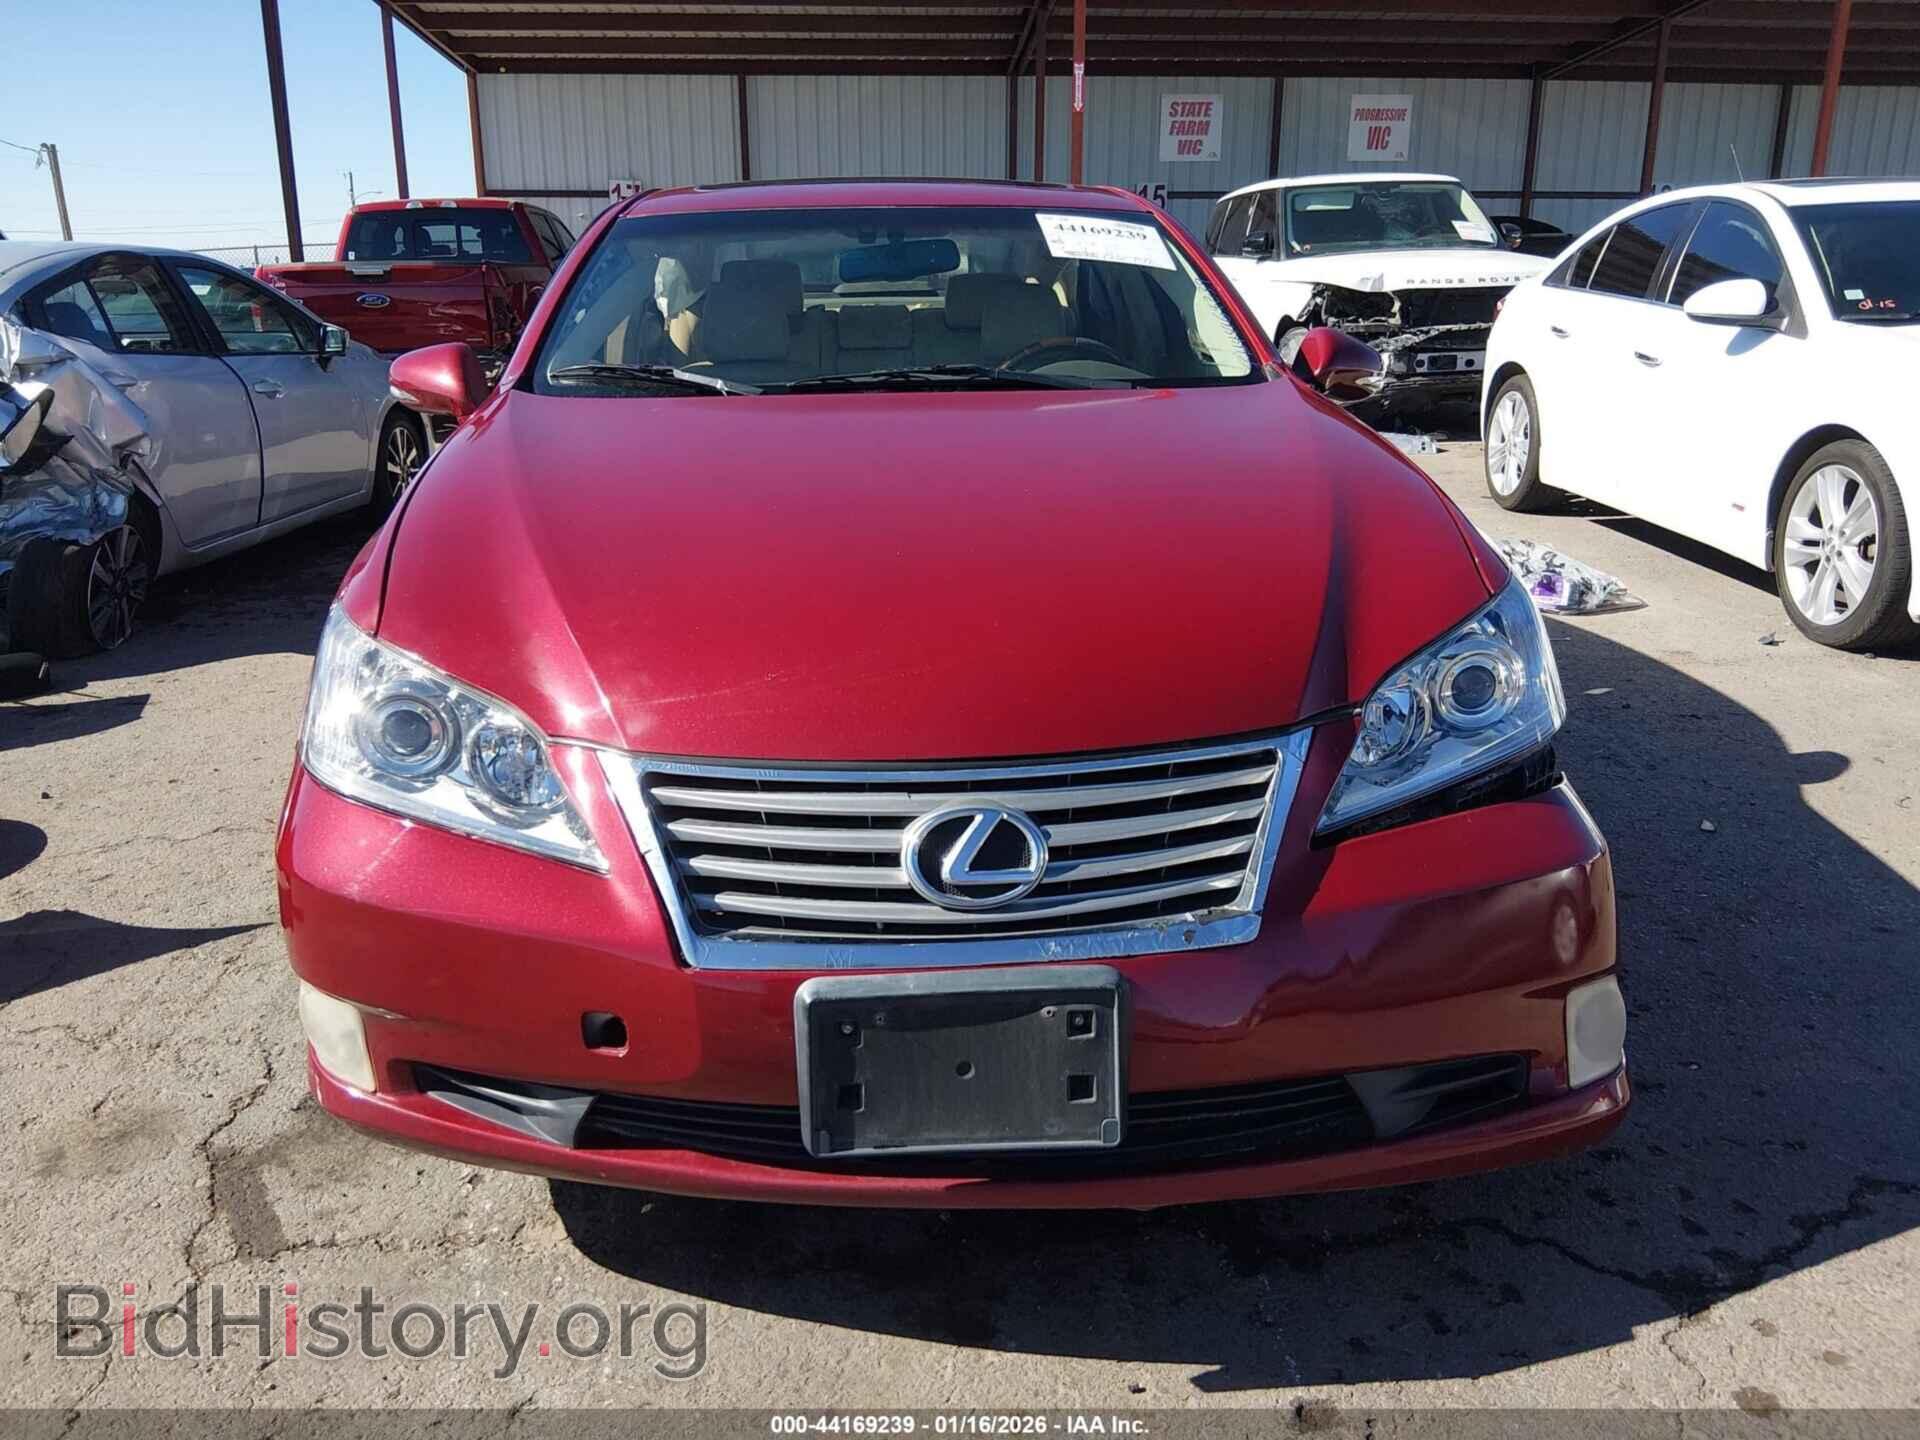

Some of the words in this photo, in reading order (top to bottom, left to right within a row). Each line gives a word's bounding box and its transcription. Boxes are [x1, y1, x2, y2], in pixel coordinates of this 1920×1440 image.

[1168, 101, 1214, 117] STATE
[1353, 107, 1408, 122] PROGRESSIVE
[1168, 120, 1211, 136] FARM
[1366, 126, 1391, 150] VIC
[1177, 139, 1204, 155] VIC
[1054, 223, 1148, 240] 44169239
[1478, 275, 1532, 283] ROVE
